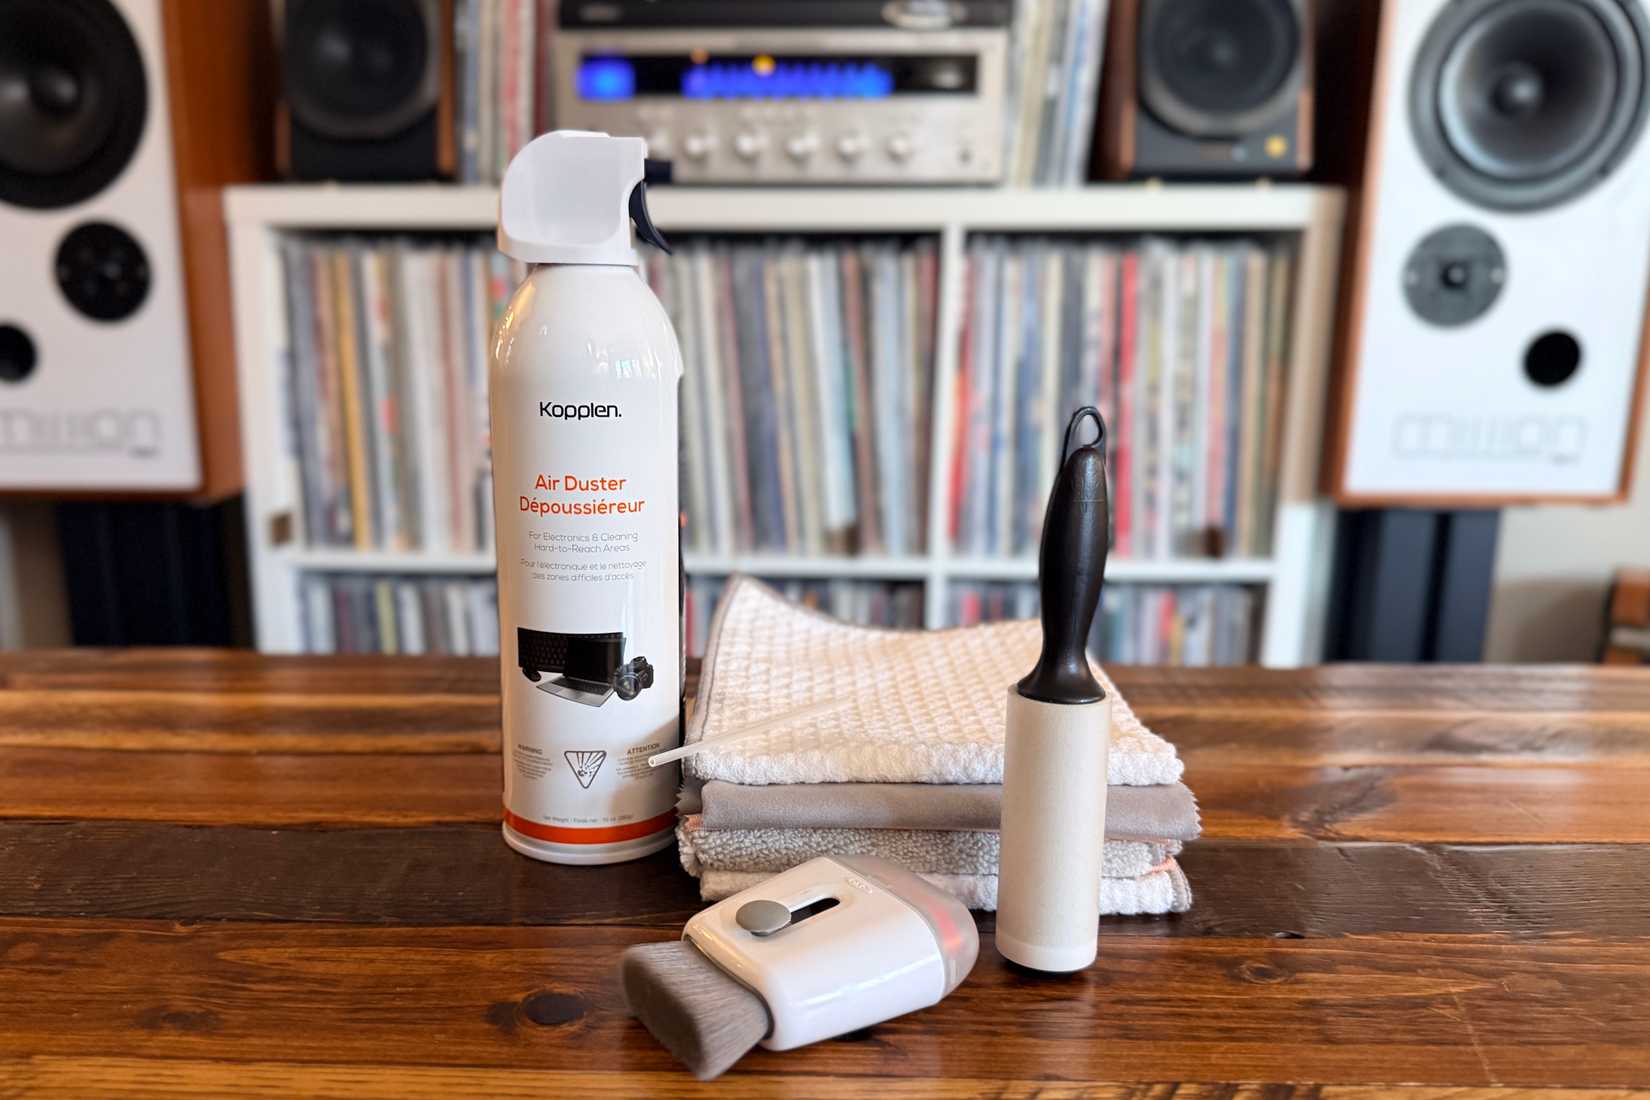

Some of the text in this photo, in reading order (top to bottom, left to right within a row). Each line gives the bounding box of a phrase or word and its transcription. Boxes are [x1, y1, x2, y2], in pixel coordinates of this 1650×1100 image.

[539, 401, 622, 421] Kopplen.
[535, 474, 627, 492] Air Duster
[519, 495, 645, 517] Dépoussiéreur
[528, 530, 639, 543] For Electronics & Cleaning
[534, 543, 631, 553] Hard-to-Reach Areas
